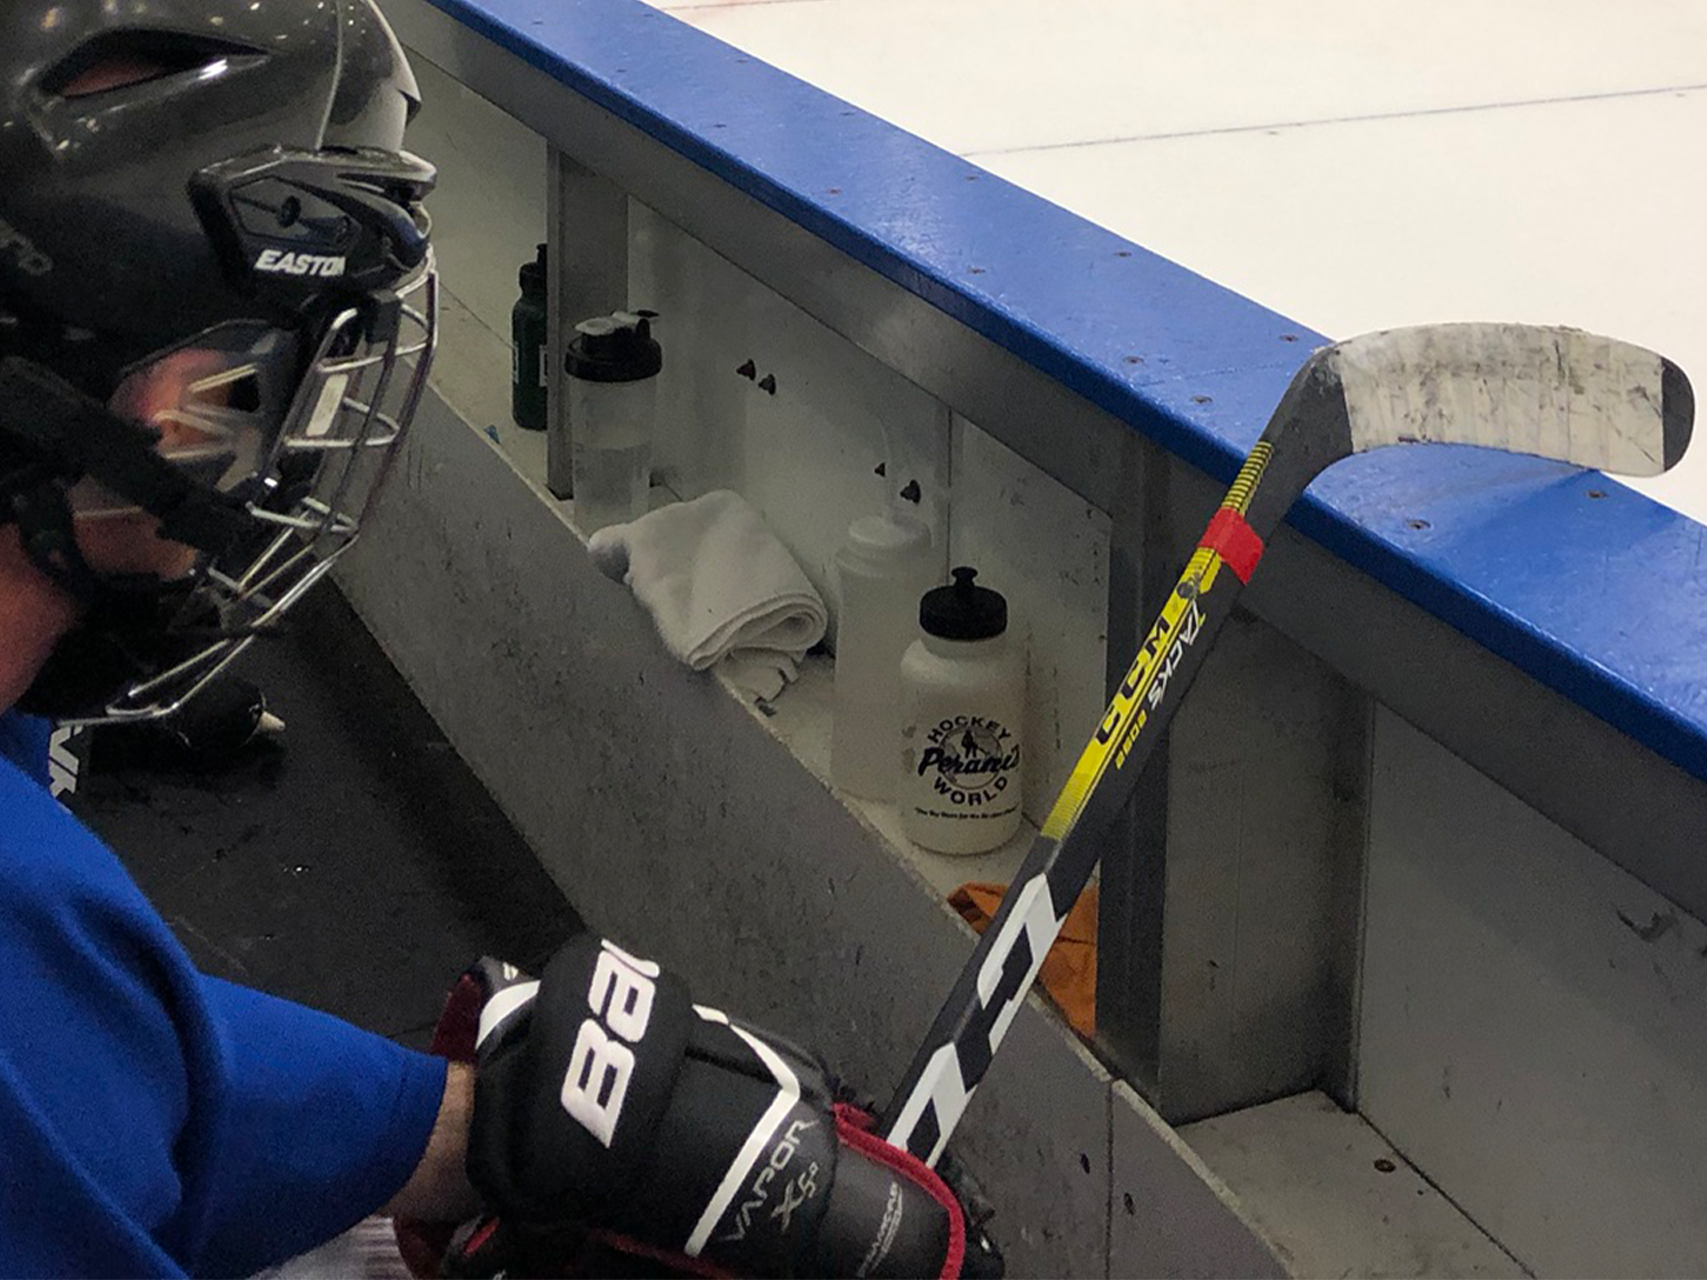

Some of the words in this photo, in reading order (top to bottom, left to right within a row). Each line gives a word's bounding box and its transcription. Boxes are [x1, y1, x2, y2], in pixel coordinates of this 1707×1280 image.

[1095, 615, 1170, 745] CCM
[1147, 599, 1206, 710] TACKS
[927, 715, 1011, 743] HOCKEY
[934, 776, 1008, 806] WORLD
[720, 1120, 820, 1241] VAPOR
